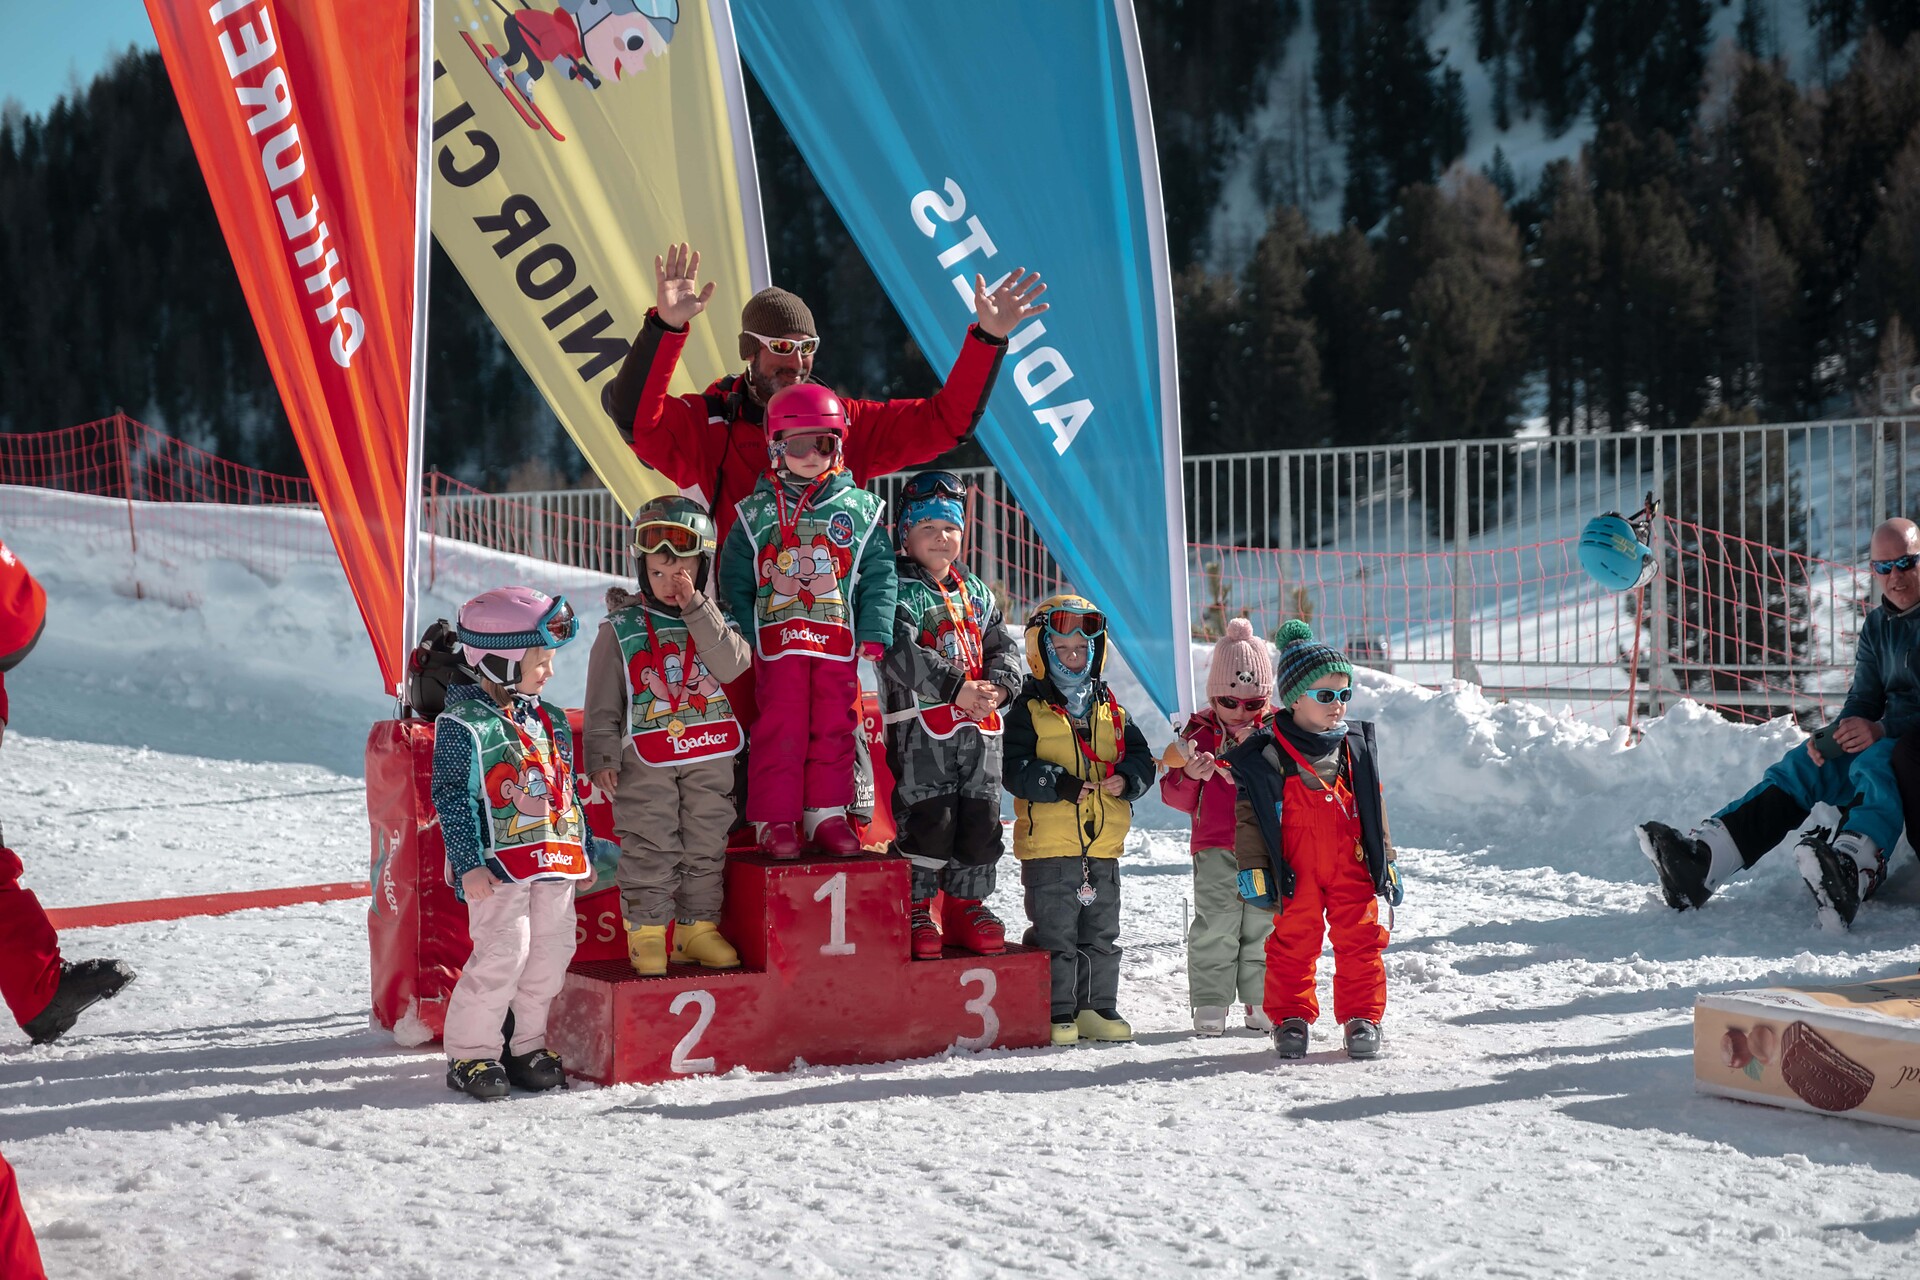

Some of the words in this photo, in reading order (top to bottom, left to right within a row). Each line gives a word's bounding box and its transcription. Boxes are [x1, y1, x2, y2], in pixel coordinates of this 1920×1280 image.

[780, 627, 830, 646] Loacker
[666, 731, 728, 754] Loacker
[529, 848, 574, 868] Loacker
[813, 872, 857, 956] 1
[668, 989, 717, 1074] 2
[956, 967, 1001, 1051] 3
